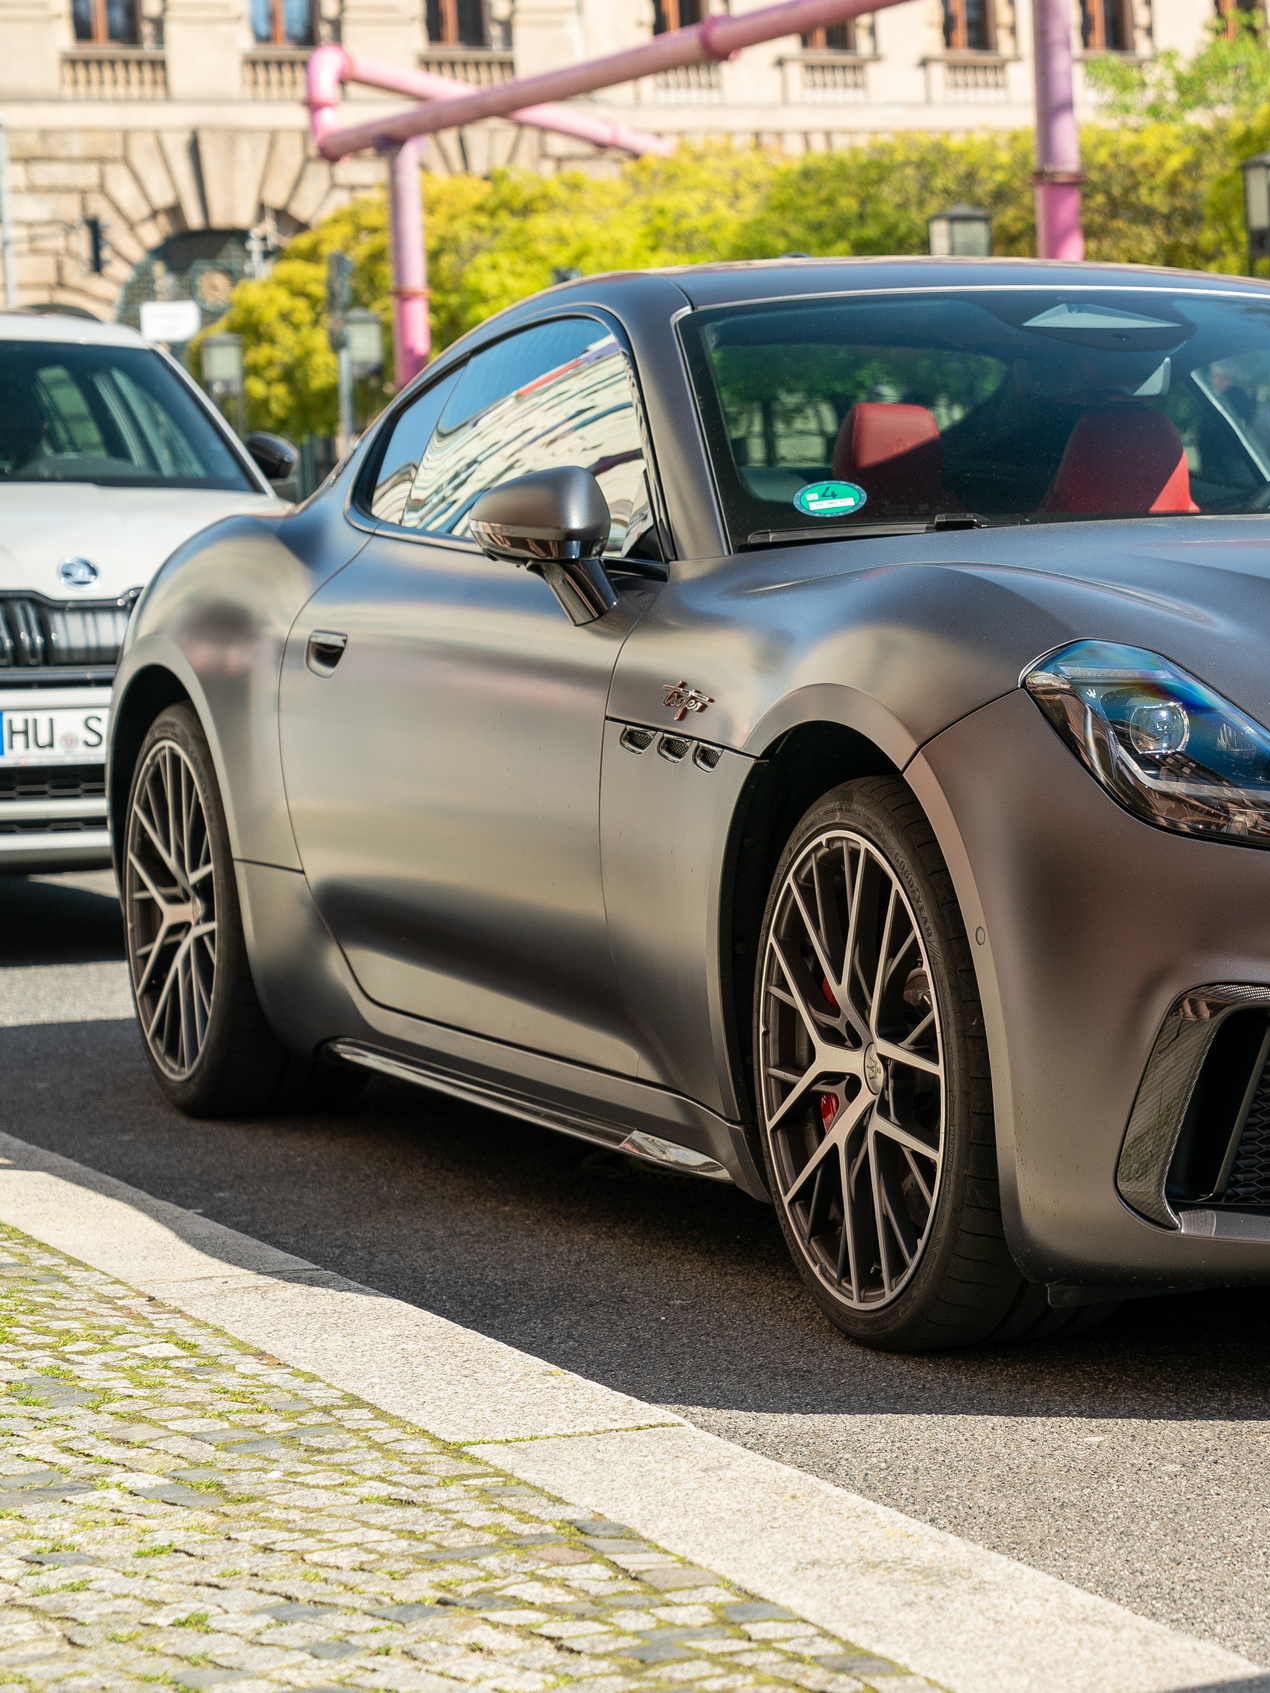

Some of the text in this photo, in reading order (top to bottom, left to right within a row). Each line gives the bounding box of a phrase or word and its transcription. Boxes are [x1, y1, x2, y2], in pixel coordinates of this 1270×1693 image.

[821, 485, 838, 498] 4
[8, 715, 104, 750] HU S
[894, 851, 934, 939] GOODYEAR
